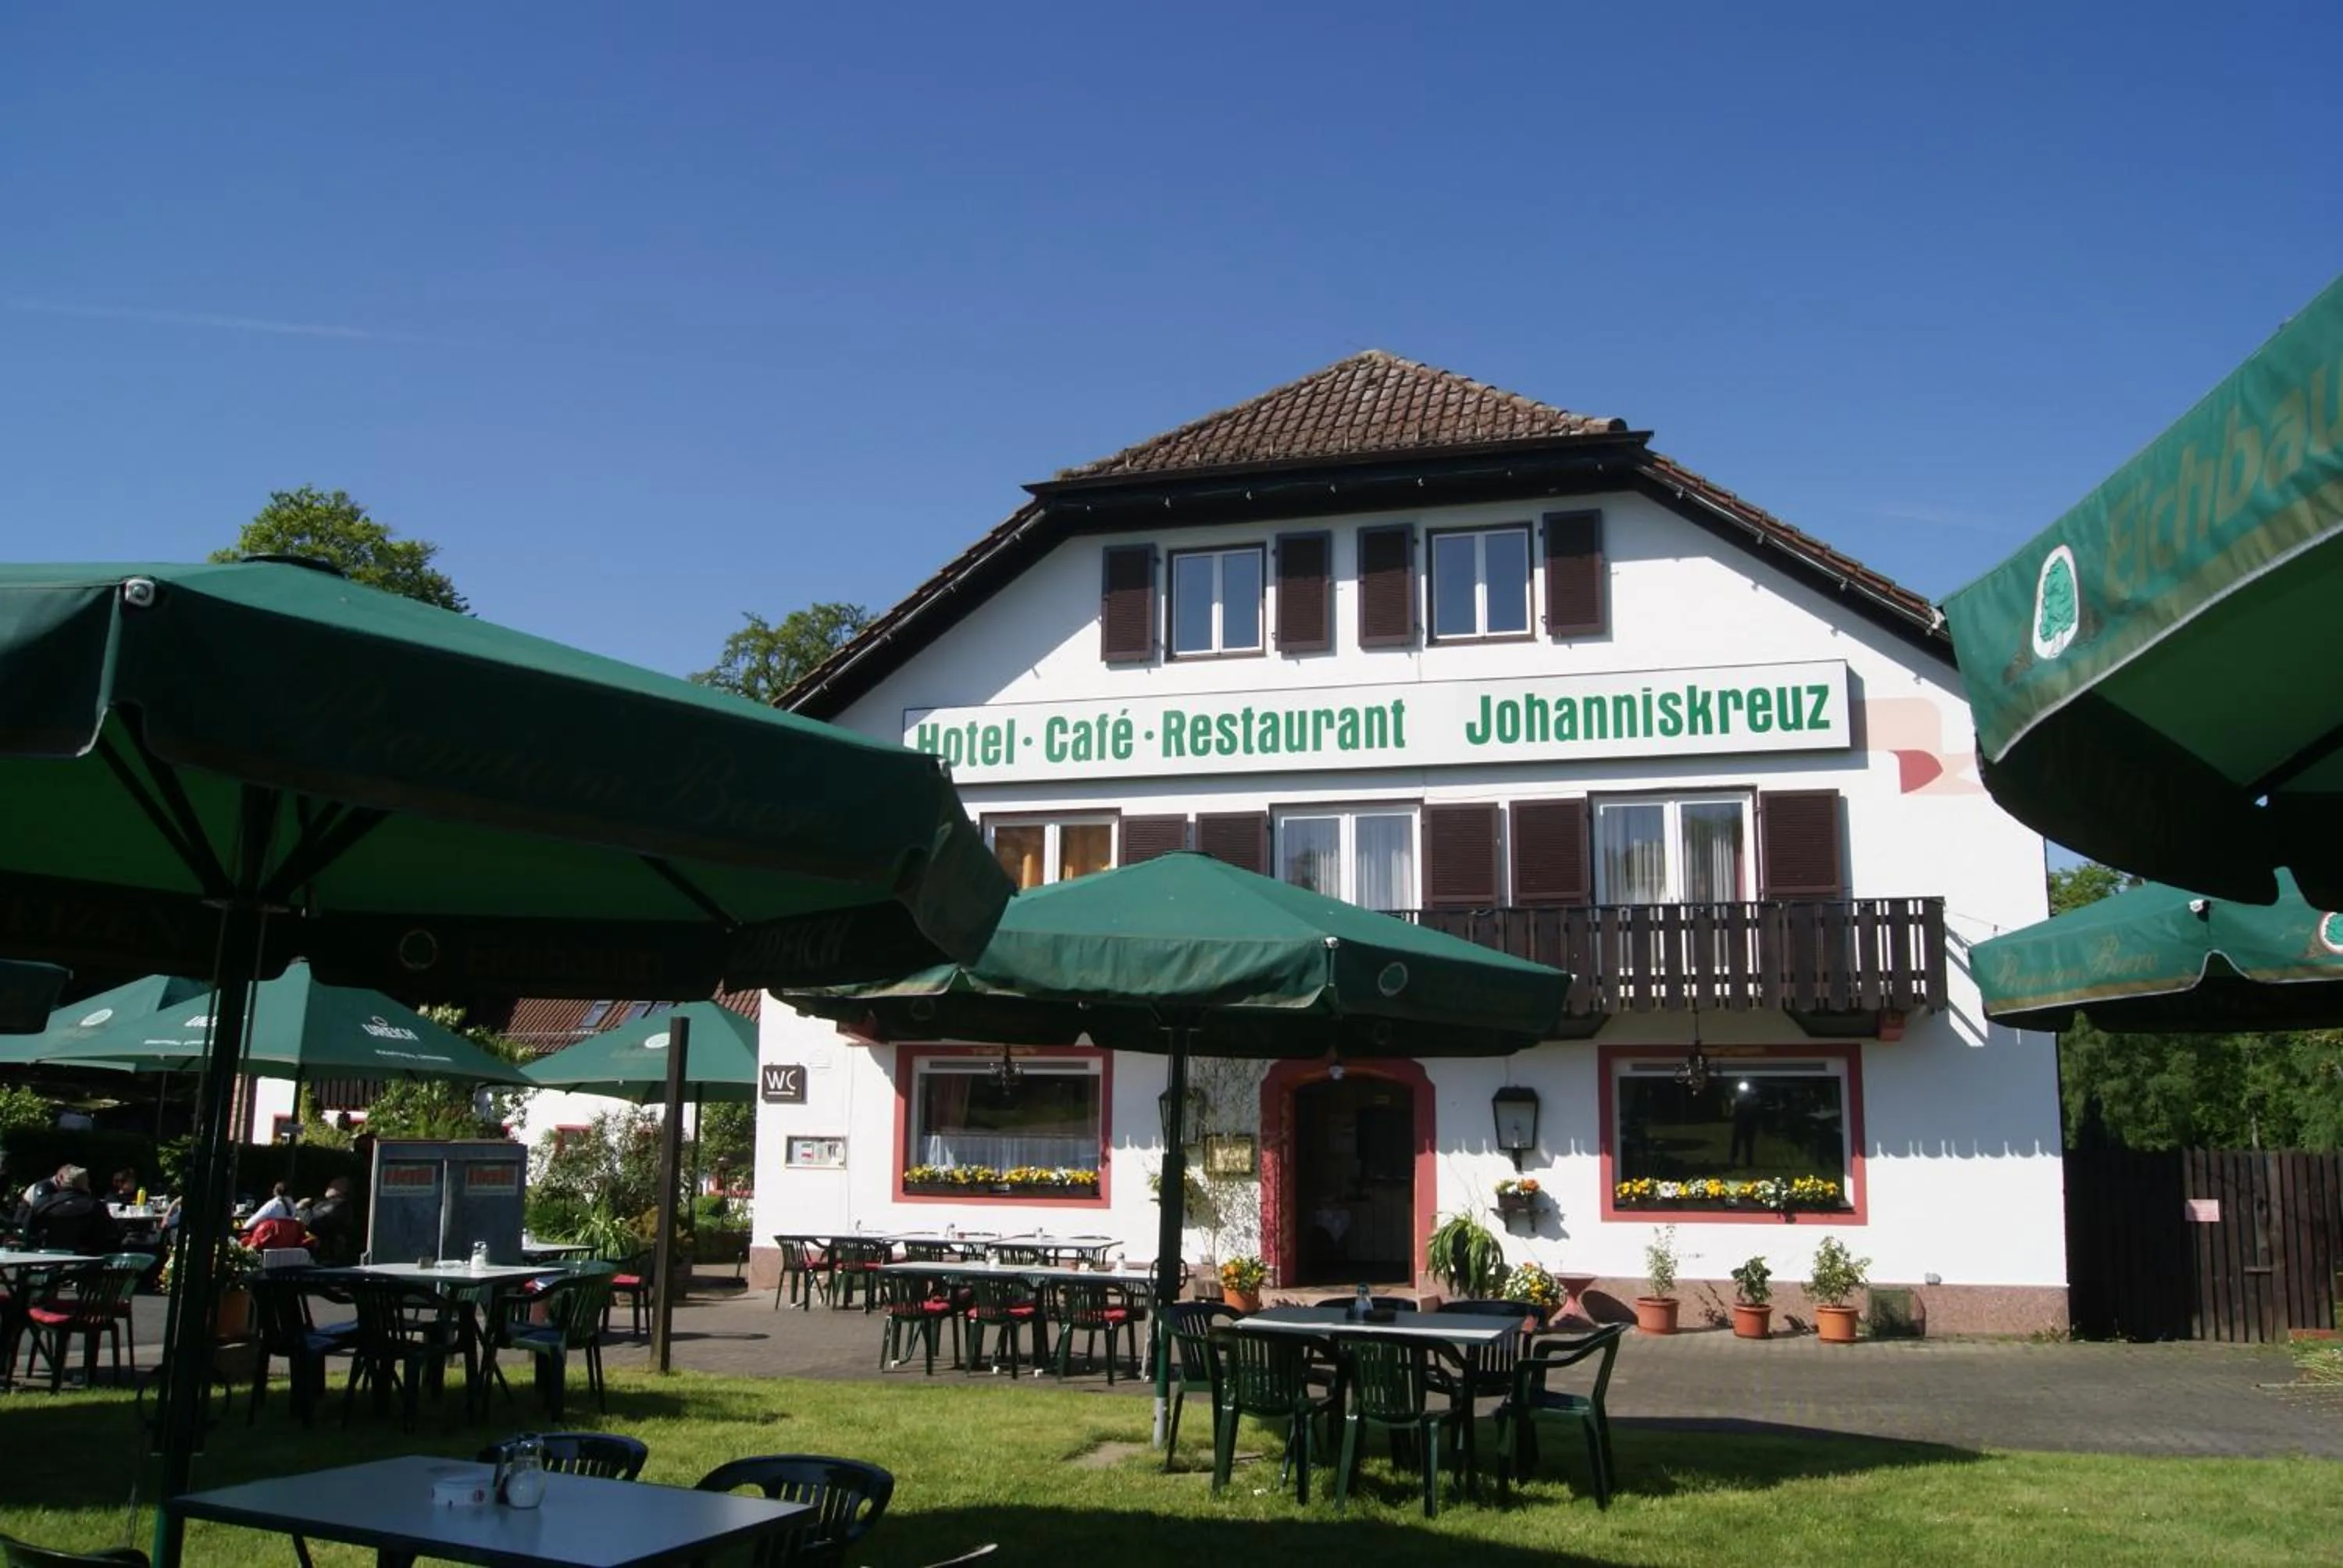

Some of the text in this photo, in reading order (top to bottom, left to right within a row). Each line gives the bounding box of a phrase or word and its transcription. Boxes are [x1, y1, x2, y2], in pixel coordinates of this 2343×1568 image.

[917, 684, 1831, 767] Hotel Café Restaurant Johanniskreuz
[765, 1070, 797, 1090] WC
